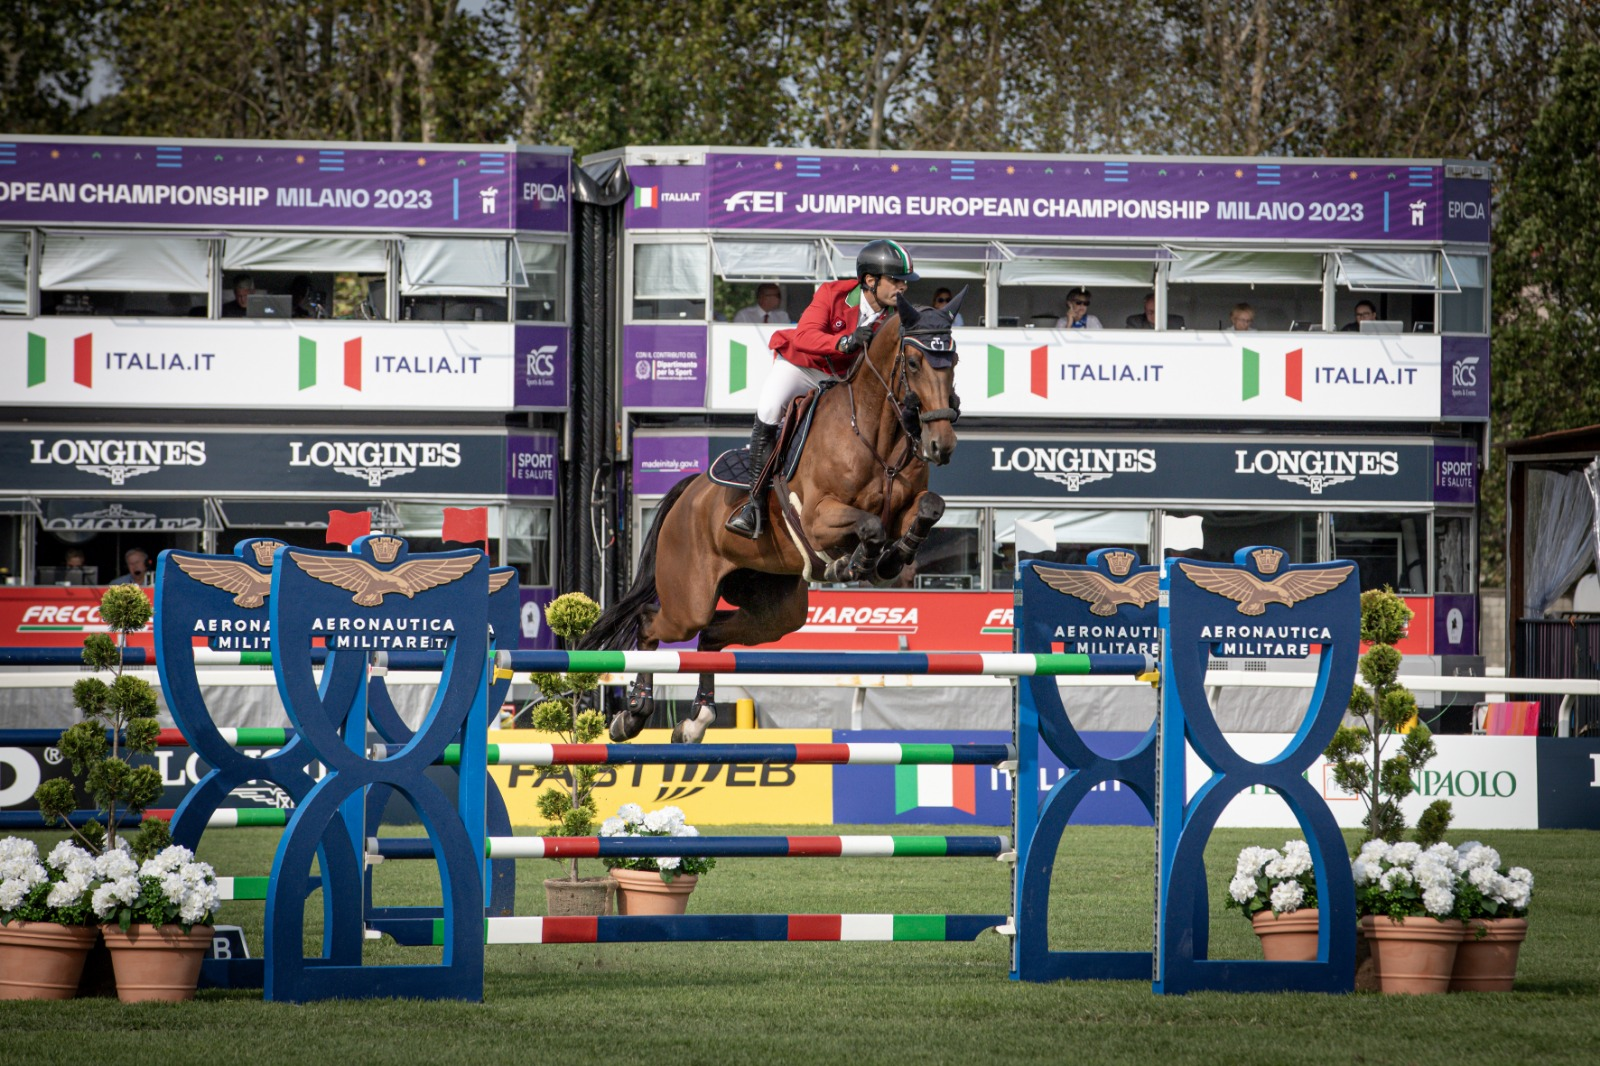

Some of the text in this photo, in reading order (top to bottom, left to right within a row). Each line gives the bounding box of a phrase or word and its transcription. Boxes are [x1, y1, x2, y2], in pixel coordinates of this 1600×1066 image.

[79, 184, 269, 206] CHAMPIONSHIP
[277, 188, 370, 208] MILANO
[374, 189, 432, 209] 2023
[661, 193, 701, 202] ITALIA.IT
[796, 194, 901, 214] JUMPING
[907, 196, 1029, 216] EUROPEAN
[1033, 198, 1209, 219] CHAMPIONSHIP
[1217, 201, 1304, 220] MILANO
[1309, 202, 1364, 221] 2023
[106, 353, 215, 370] ITALIA.IT
[376, 356, 481, 373] ITALIA.IT
[527, 354, 554, 376] RCS
[1062, 364, 1163, 381] ITALIA.IT
[1316, 367, 1417, 384] ITALIA.IT
[1453, 365, 1476, 386] RCS
[31, 440, 206, 466] LONGINES
[290, 442, 461, 467] LONGINES
[518, 453, 553, 468] SPORT
[992, 448, 1157, 473] LONGINES
[1235, 450, 1399, 475] LONGINES
[1442, 461, 1472, 475] SPORT
[518, 469, 554, 480] E SALUTE
[1448, 477, 1472, 487] SALUTE
[312, 618, 454, 631] AERONAUTICA
[1201, 626, 1331, 638] AERONAUTICA
[337, 635, 430, 649] MILITARE
[1077, 642, 1159, 655] MILITARE
[1224, 643, 1310, 656] MILITARE
